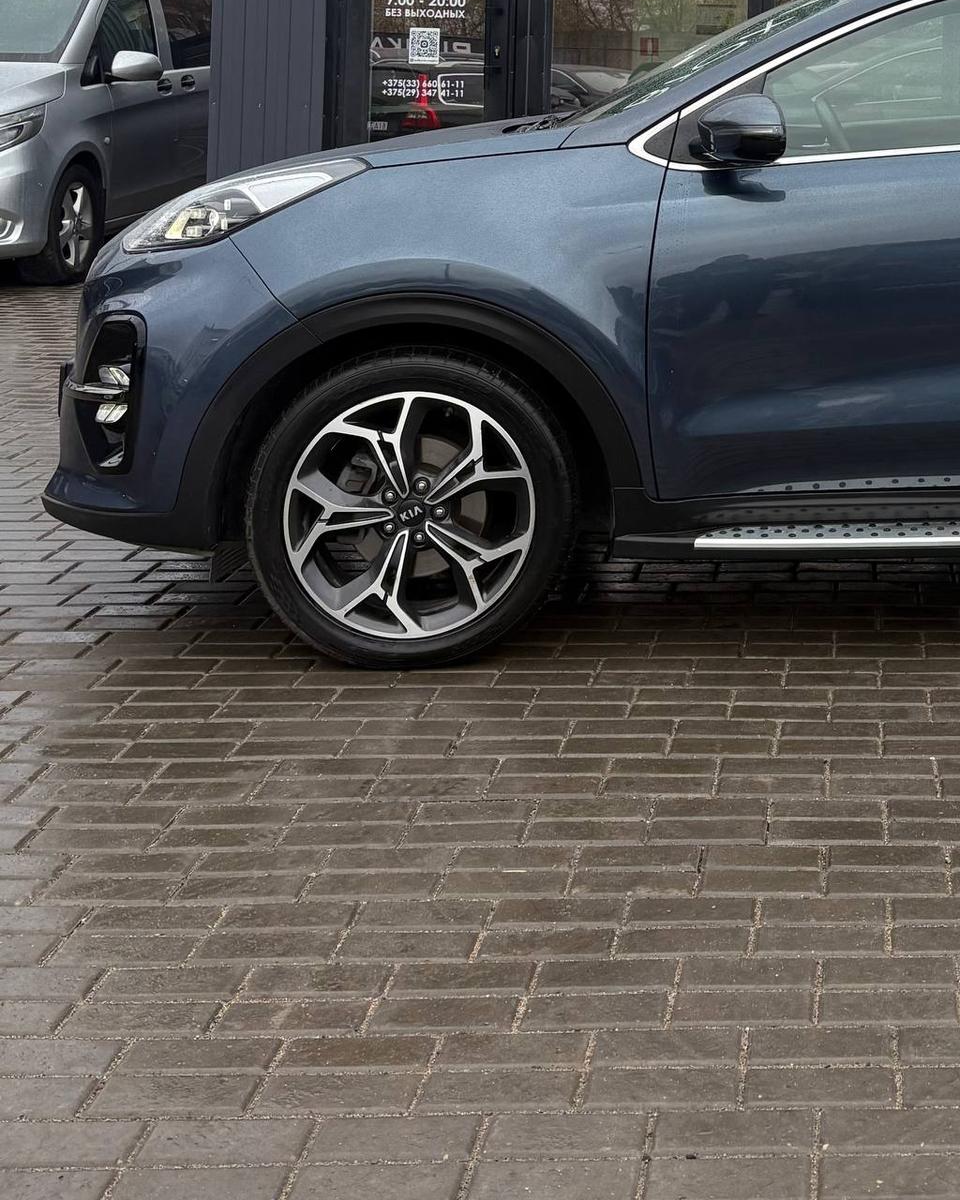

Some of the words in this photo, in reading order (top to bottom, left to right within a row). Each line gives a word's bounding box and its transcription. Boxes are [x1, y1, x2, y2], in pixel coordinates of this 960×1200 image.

[385, 8, 402, 17] БЕЗ
[405, 9, 465, 19] ВЫХОДНЫХ
[400, 506, 423, 521] KIA
